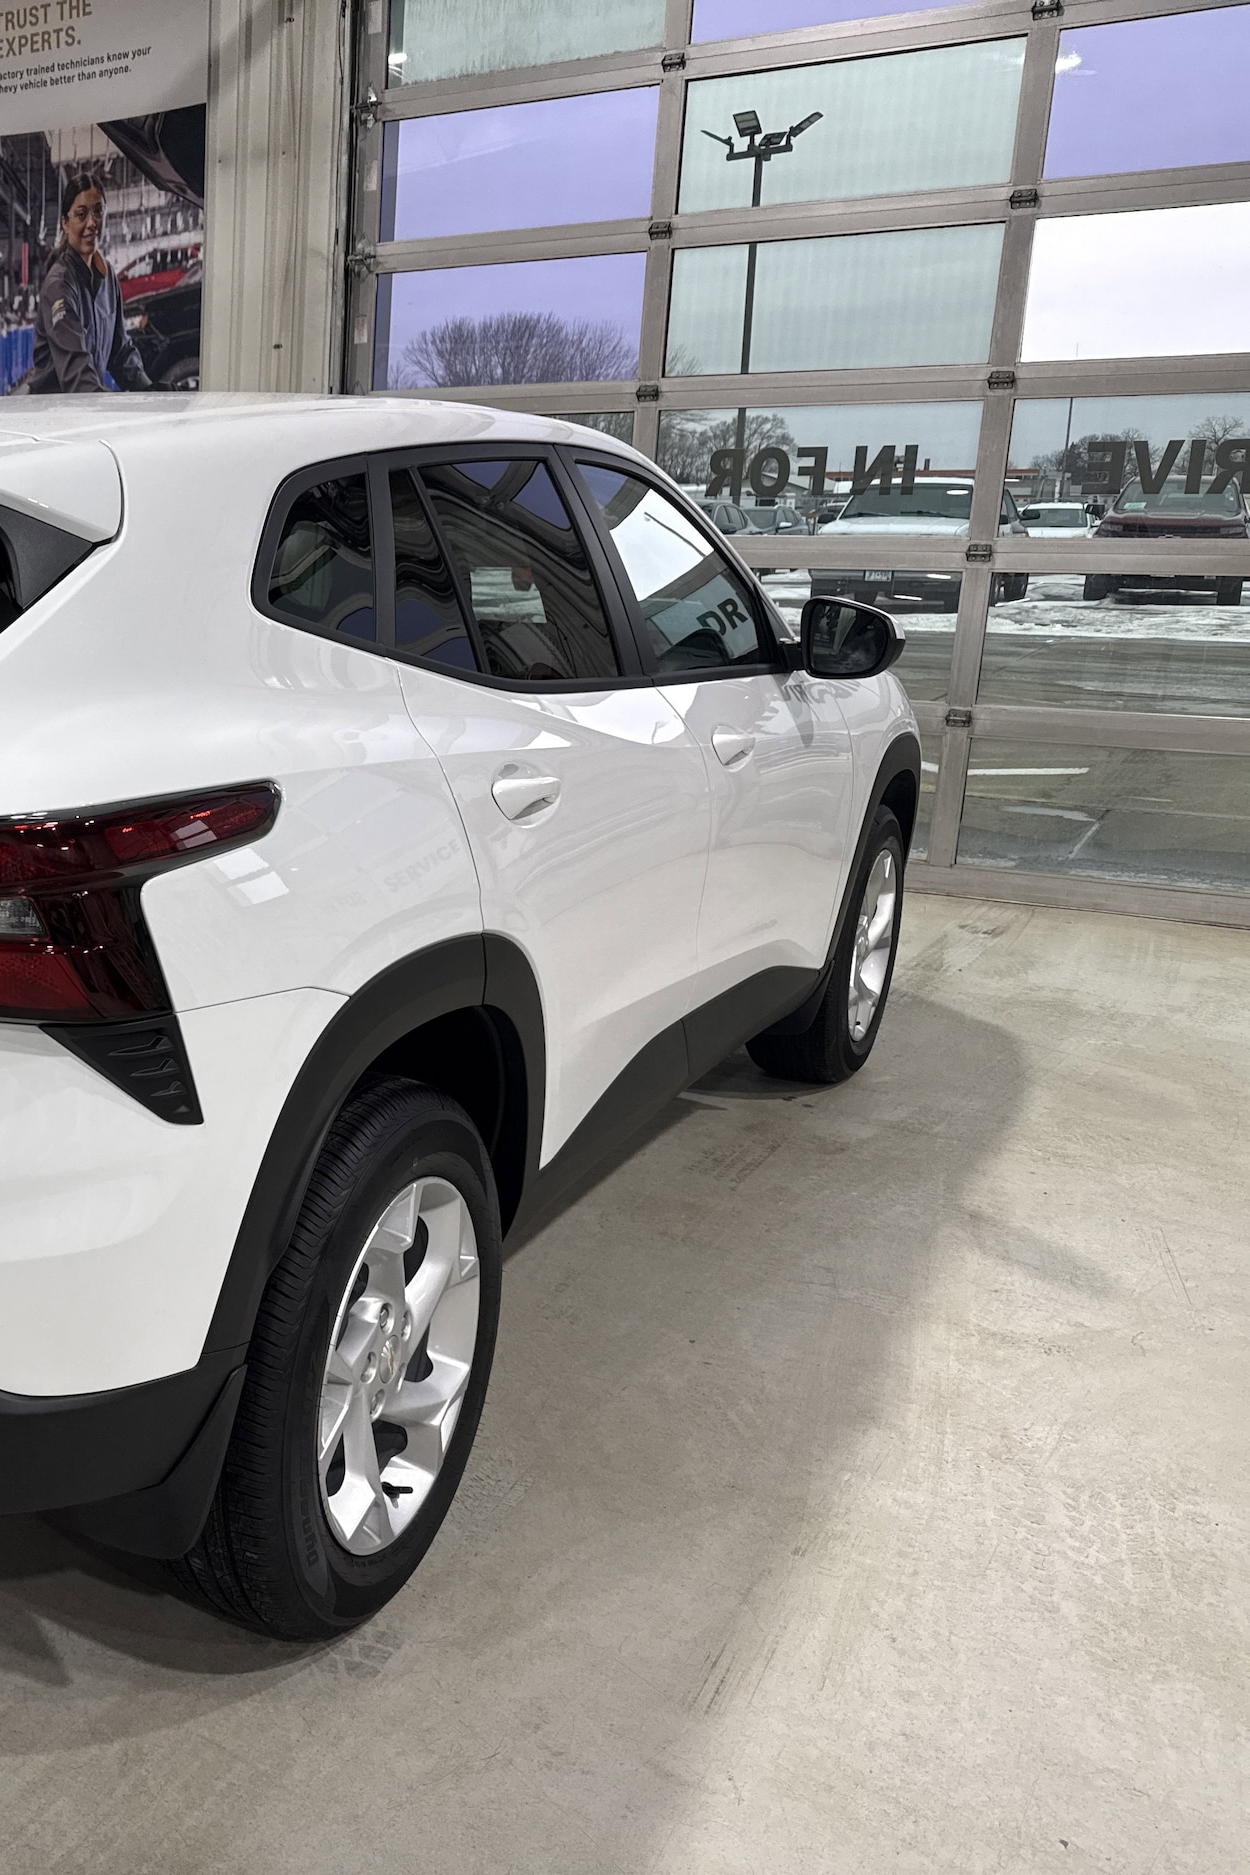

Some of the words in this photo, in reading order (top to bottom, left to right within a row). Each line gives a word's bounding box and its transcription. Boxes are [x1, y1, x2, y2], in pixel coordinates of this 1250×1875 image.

[56, 0, 92, 21] THE
[26, 61, 55, 77] trained
[57, 54, 105, 72] technicians
[106, 50, 130, 63] know
[131, 46, 152, 60] your
[20, 76, 48, 91] vehicle
[50, 74, 76, 87] better
[77, 70, 97, 82] than
[98, 64, 132, 80] anyone.
